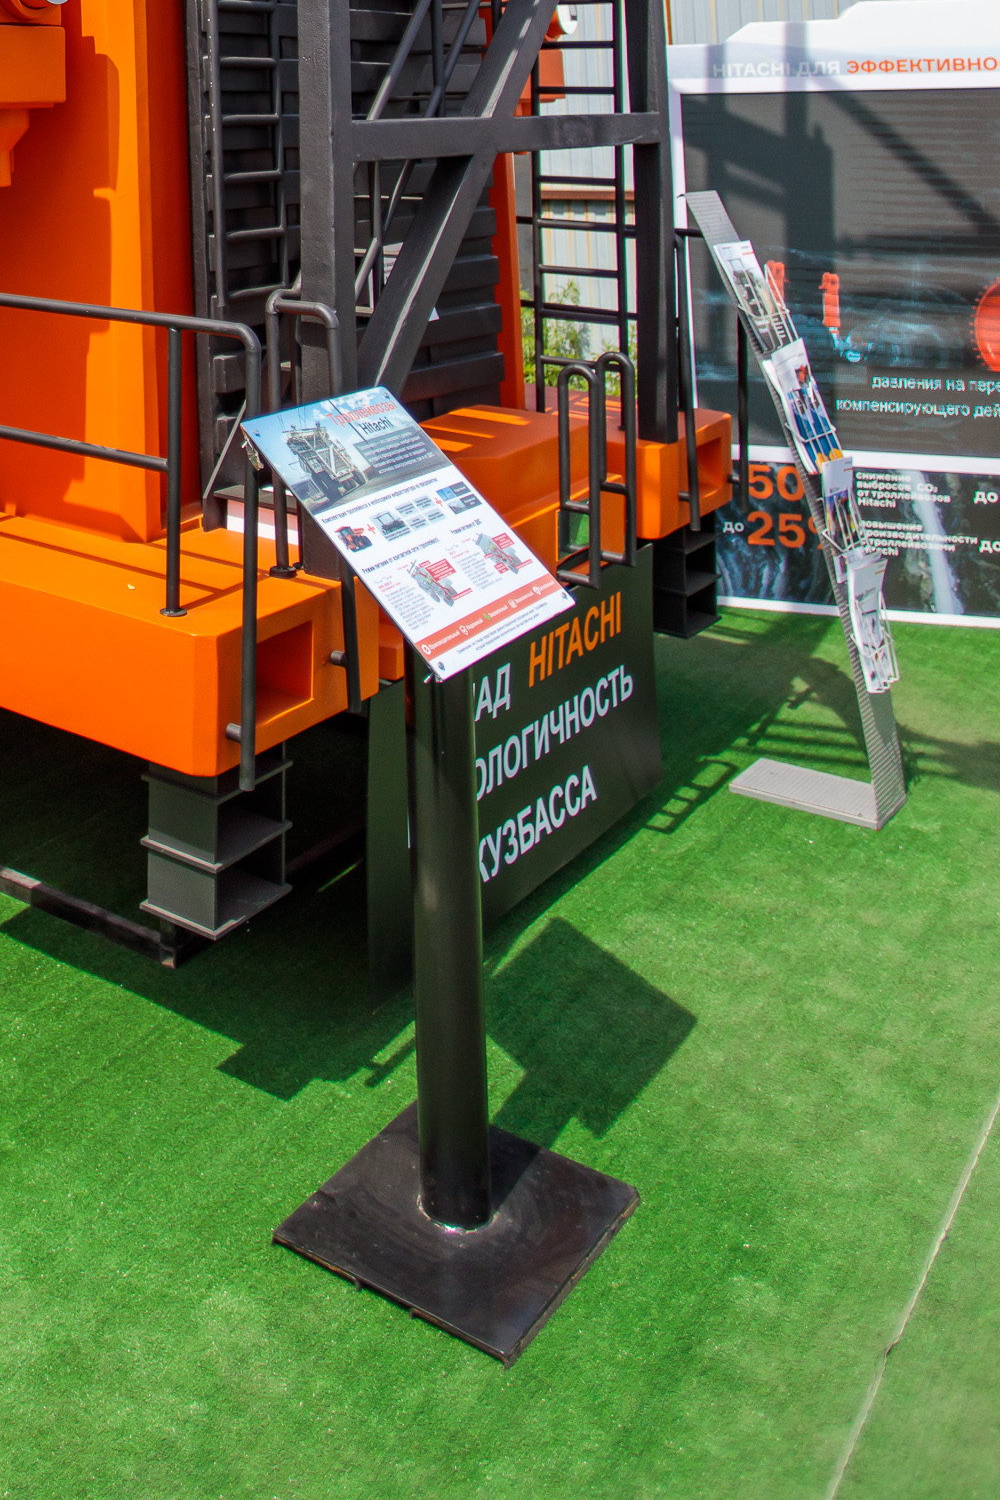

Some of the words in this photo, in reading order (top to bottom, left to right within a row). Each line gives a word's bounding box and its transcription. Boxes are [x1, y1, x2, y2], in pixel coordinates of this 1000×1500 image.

[713, 61, 790, 78] HITACHI
[796, 60, 841, 78] ДЛЯ
[846, 56, 1000, 75] ЭФФЕКТИВНО
[871, 376, 942, 390] давления
[946, 379, 966, 392] на
[326, 400, 398, 428] Троллейвозы
[836, 399, 971, 419] компенсирующего
[358, 416, 394, 435] Hitachi
[855, 471, 912, 483] снижение
[856, 480, 912, 492] выбросов
[856, 489, 870, 498] от
[871, 490, 952, 504] троллейвозов
[857, 496, 897, 508] Hitachi
[473, 662, 511, 722] АД
[528, 591, 622, 688] HITACHI
